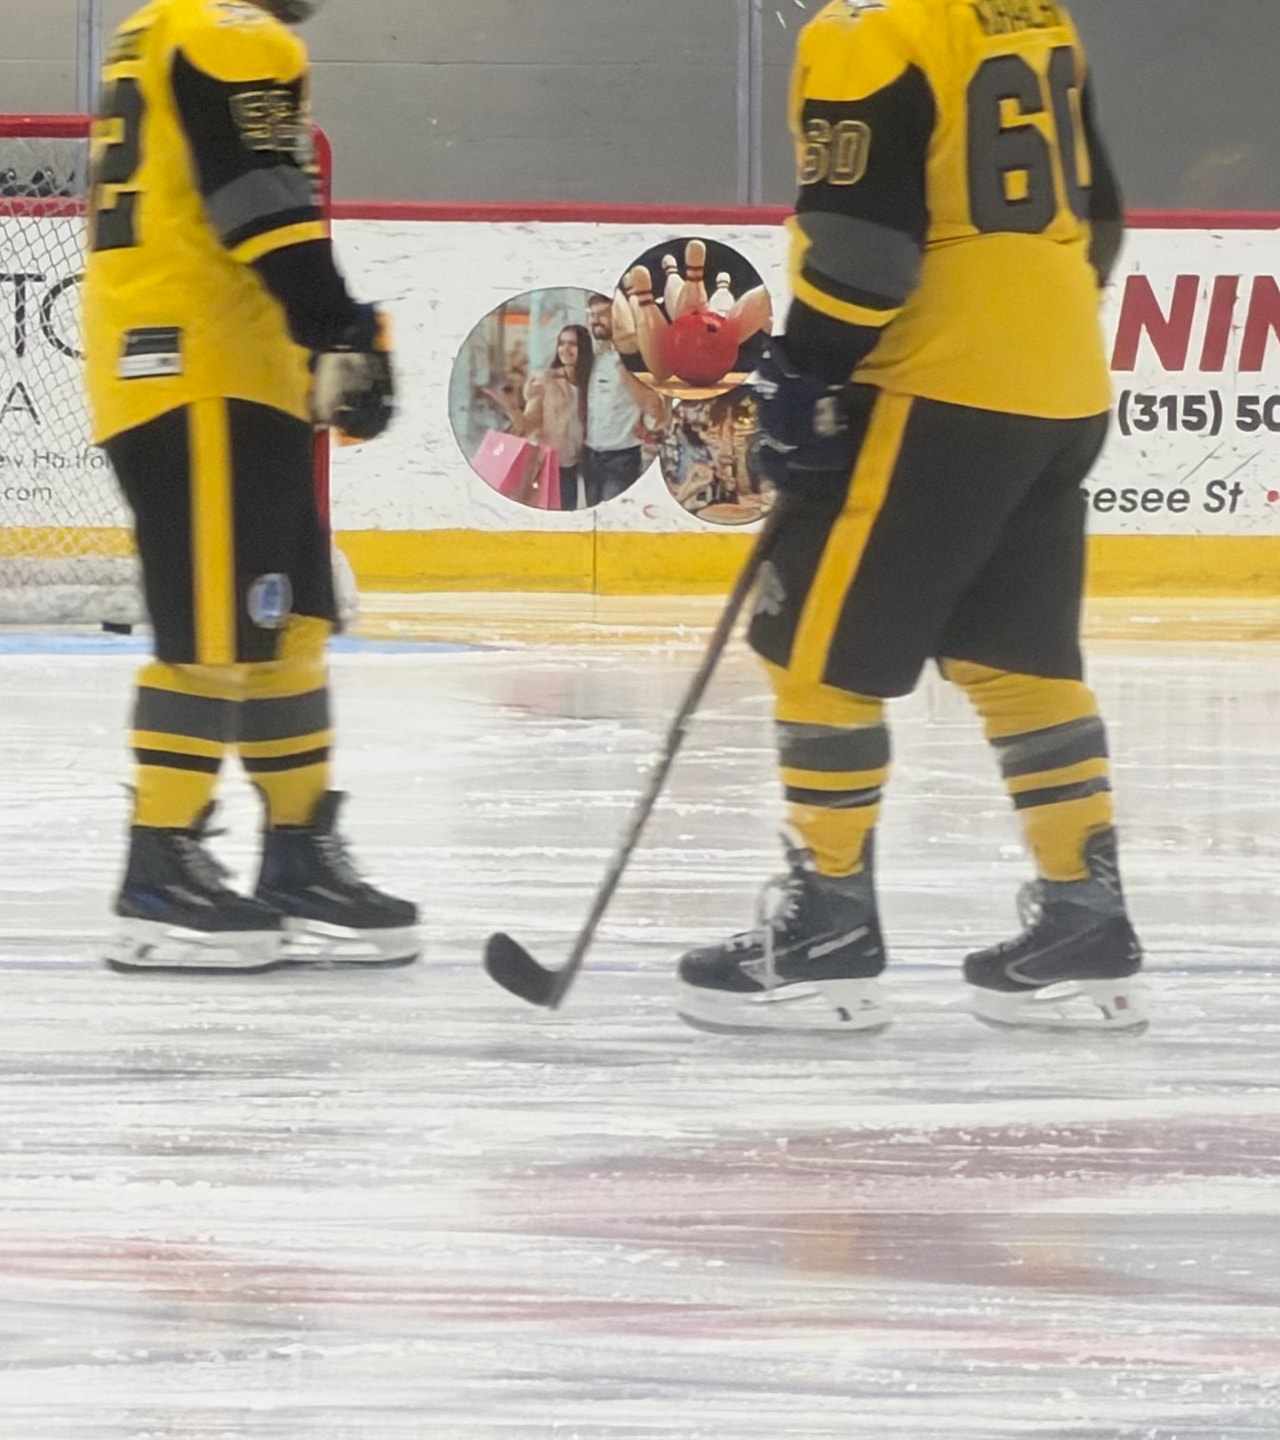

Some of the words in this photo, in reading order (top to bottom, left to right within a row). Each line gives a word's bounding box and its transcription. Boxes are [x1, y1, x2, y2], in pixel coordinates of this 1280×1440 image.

[1118, 390, 1222, 436] (315)
[1082, 485, 1190, 514] esee
[1203, 480, 1244, 514] St
